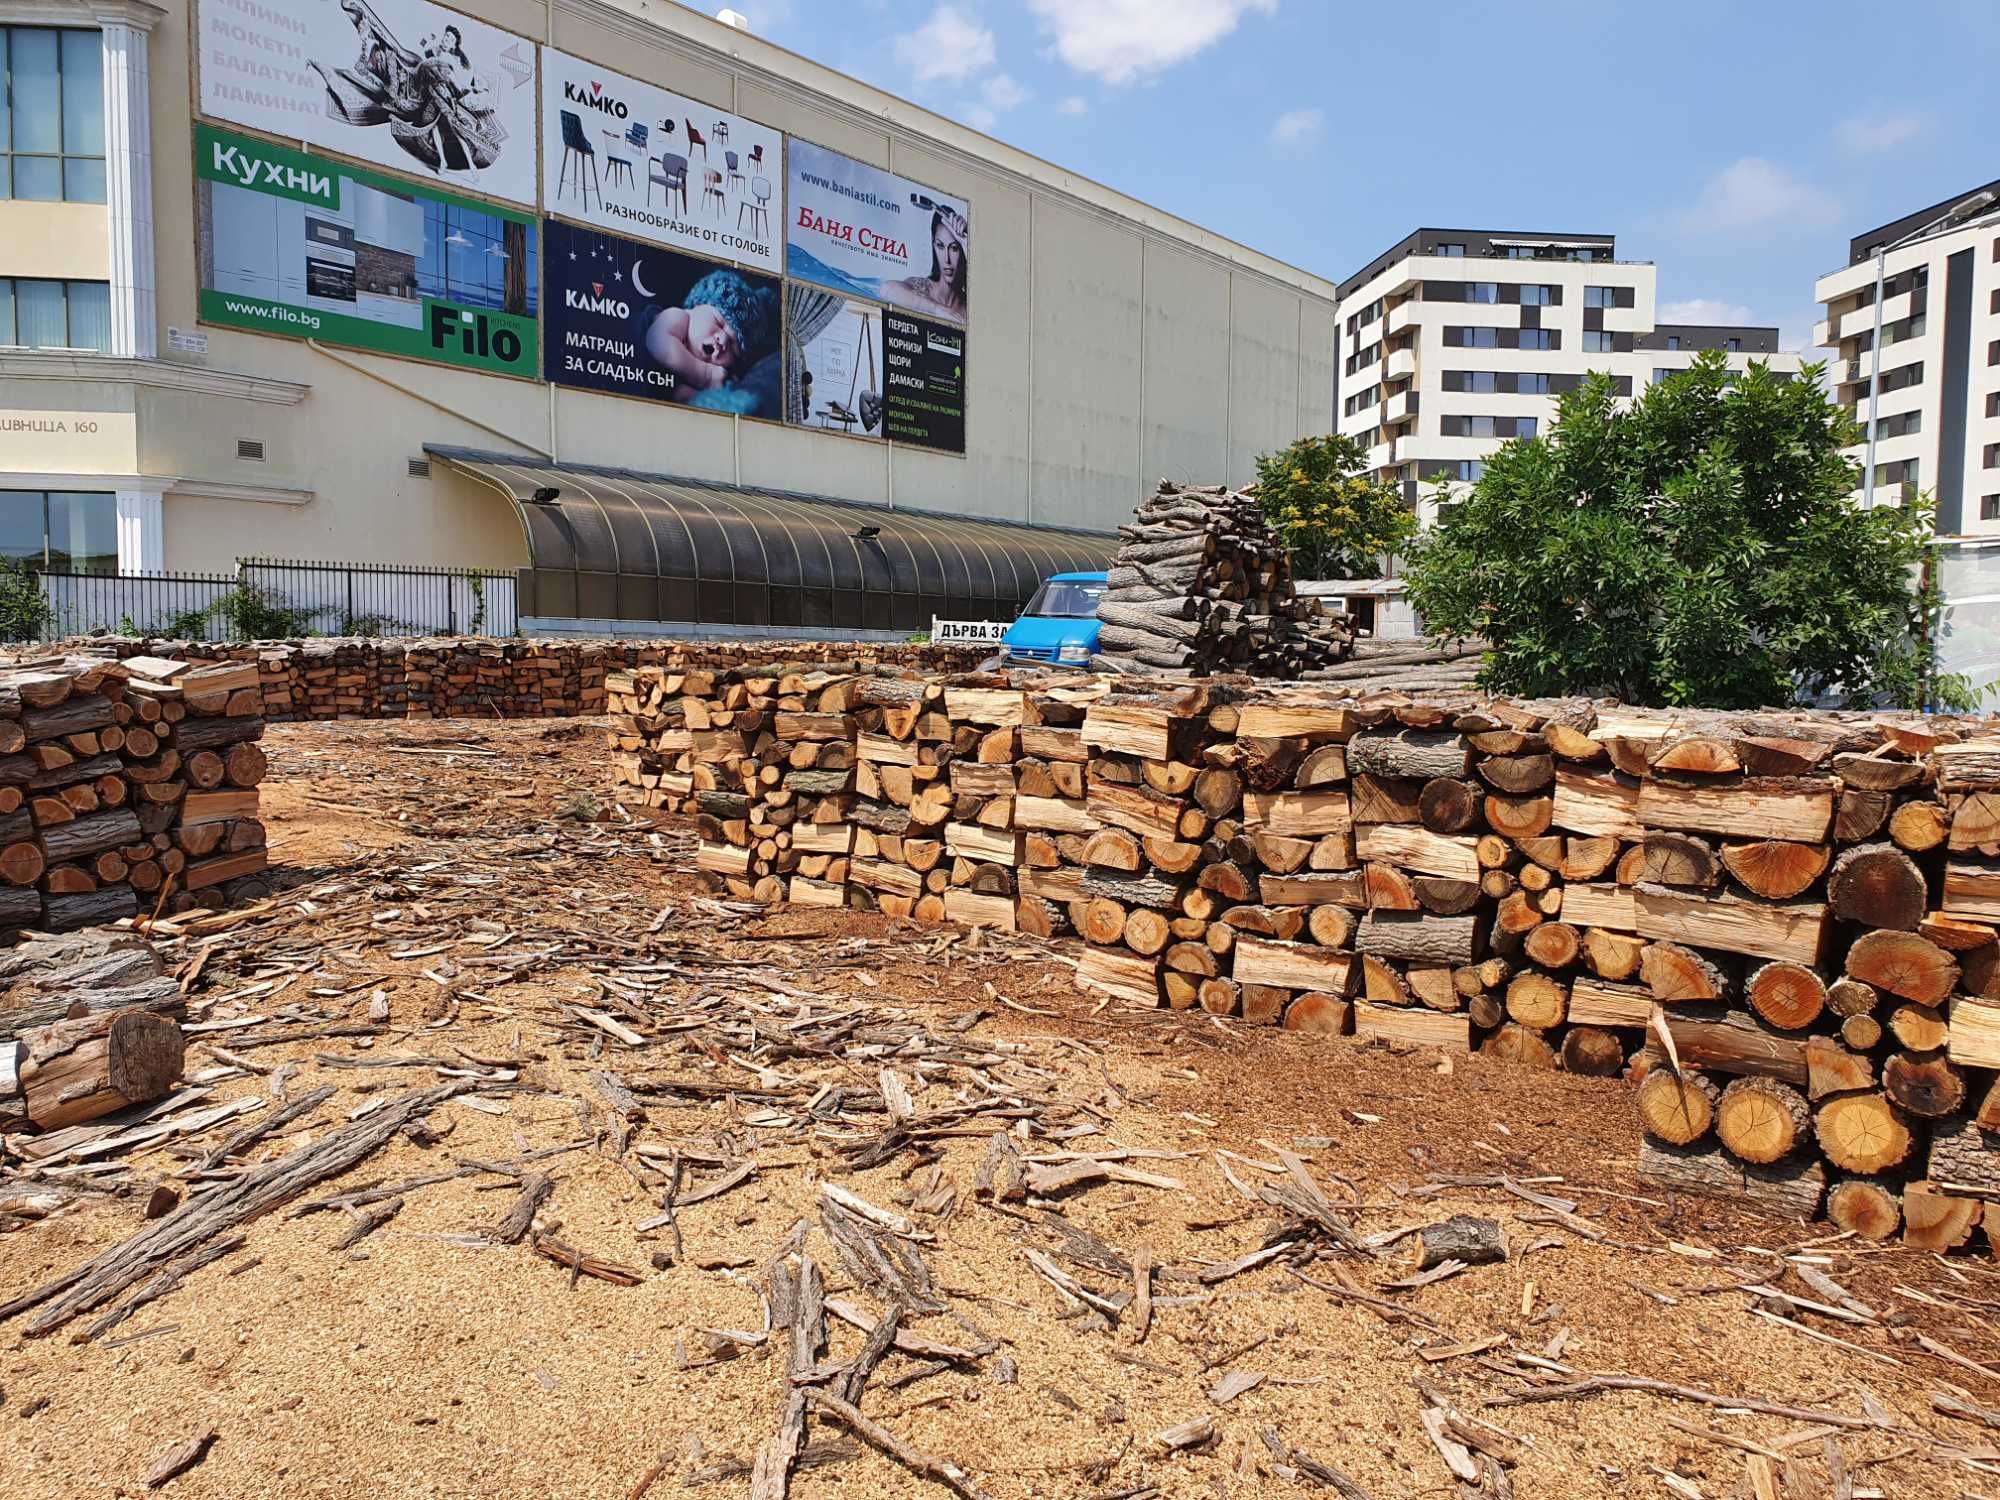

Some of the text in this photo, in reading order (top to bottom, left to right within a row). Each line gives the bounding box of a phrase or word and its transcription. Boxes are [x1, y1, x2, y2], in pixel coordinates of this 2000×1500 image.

[210, 18, 302, 59] МОКЕТИ
[212, 49, 314, 89] БАЛАТУМ
[213, 81, 320, 115] ЛАМИНАТ
[564, 80, 629, 119] КАМКО
[212, 141, 331, 198] Кухни
[800, 171, 901, 214] www.baniastil.com
[605, 202, 771, 257] РАЗНООБРАЗИЕ ОТ СТОЛОВЕ
[225, 300, 321, 330] www.filo.bg
[565, 288, 630, 320] КАМКО
[431, 303, 522, 362] Filo
[888, 317, 920, 336] ПЕРДЕТА
[565, 331, 635, 360] МАТРАЦИ
[888, 337, 923, 355] КОРНИЗИ
[888, 354, 911, 368] ЩОРИ
[565, 355, 675, 388] ЗА СЛАДЪК СЪН
[889, 372, 925, 390] ДАМАСКИ
[74, 421, 98, 434] 160
[942, 625, 987, 638] ДЪРВА
